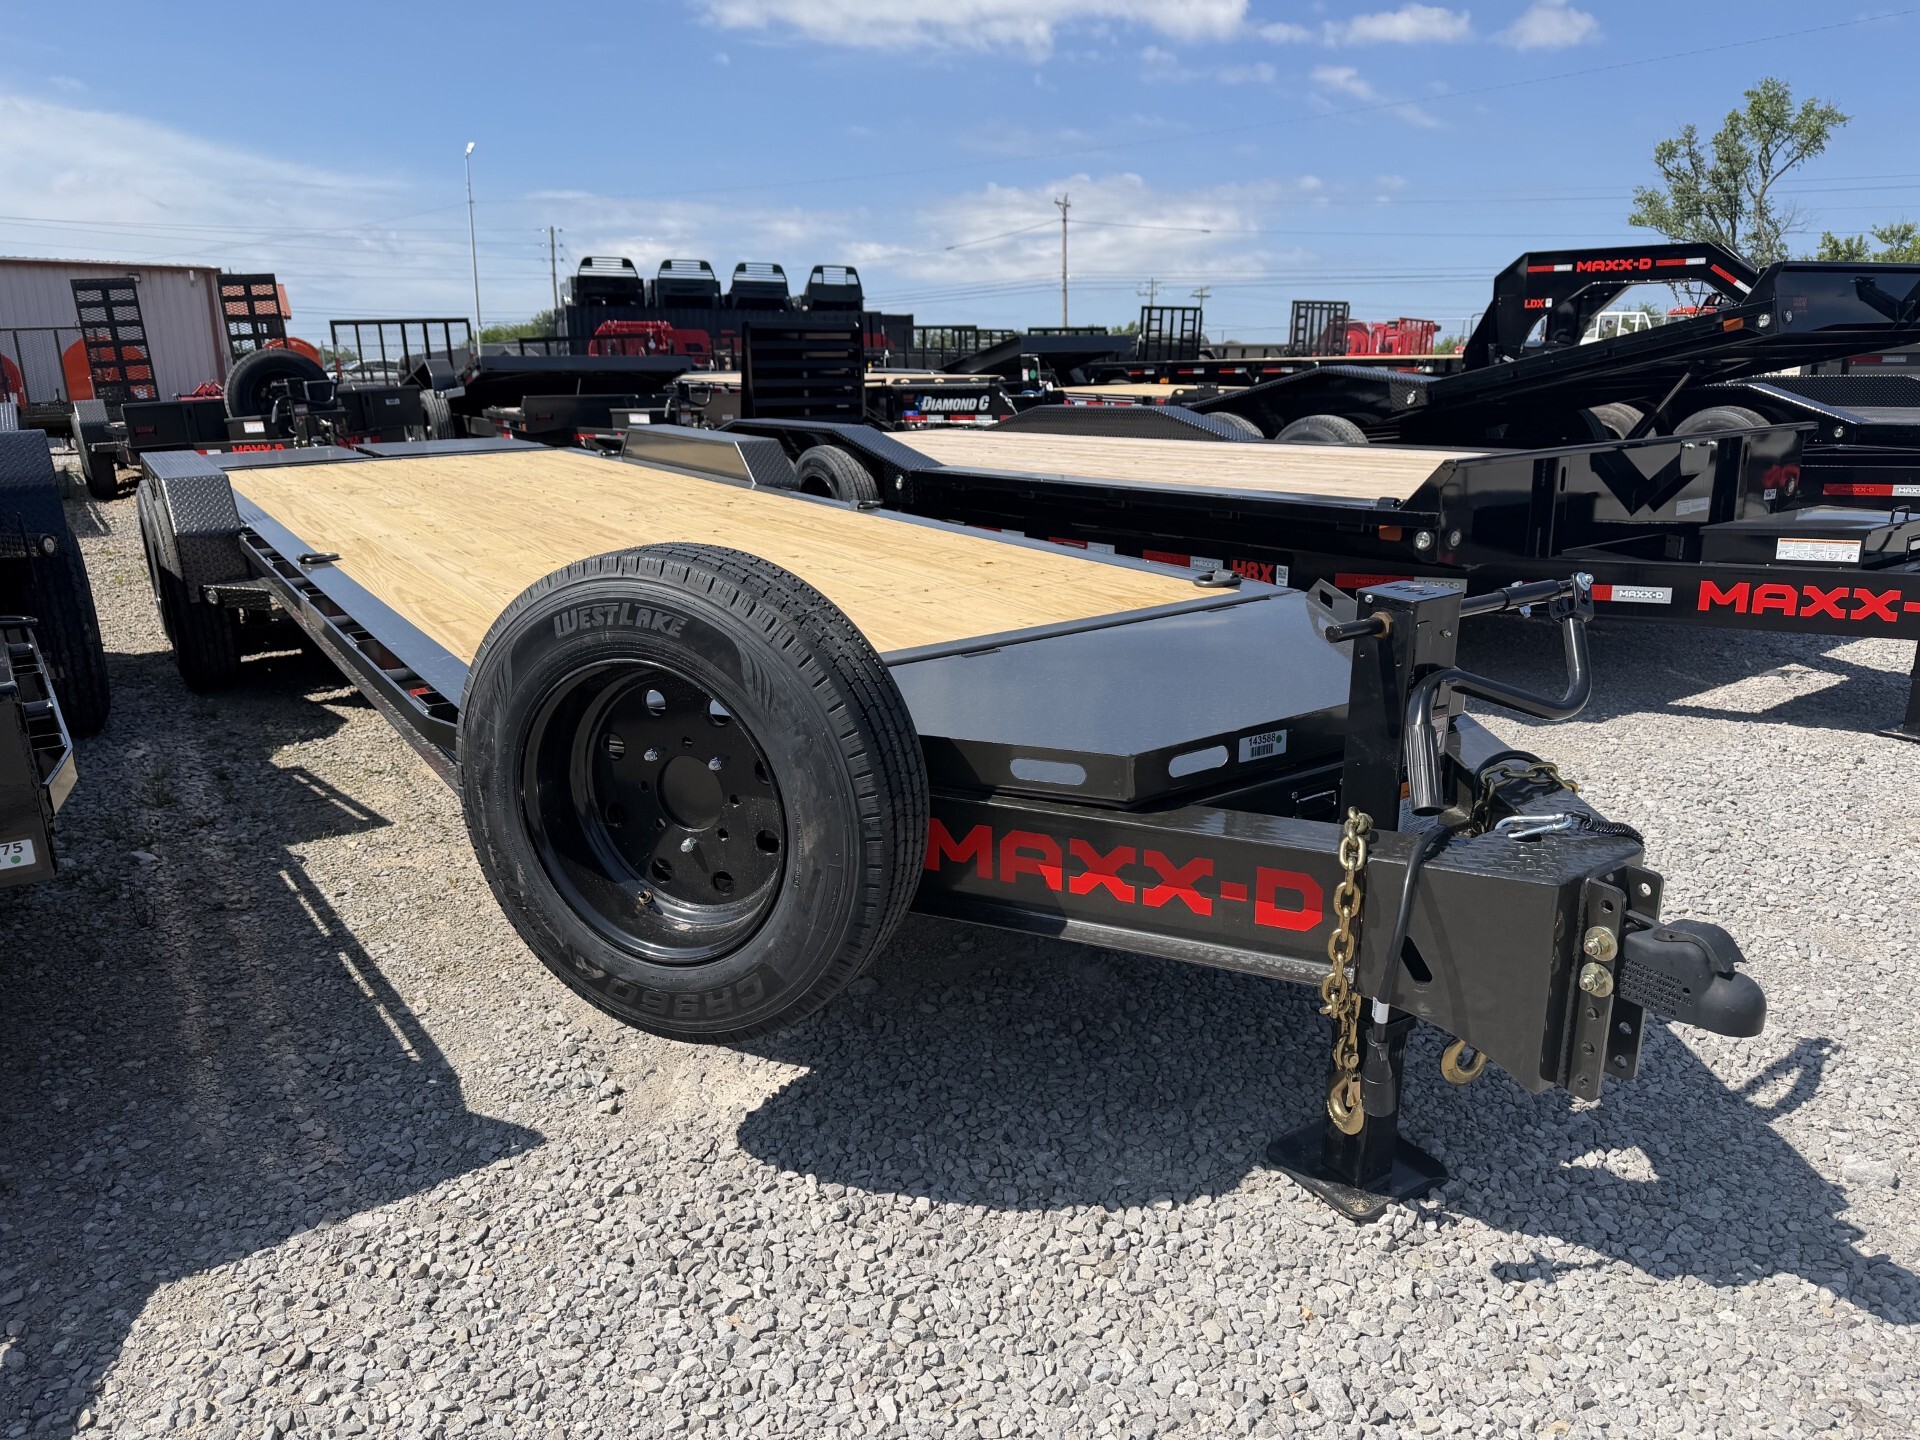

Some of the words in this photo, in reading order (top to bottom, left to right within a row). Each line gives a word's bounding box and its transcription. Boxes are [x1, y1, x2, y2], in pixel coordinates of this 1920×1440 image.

[1577, 258, 1651, 273] MAXX-D
[1524, 299, 1544, 308] LDX
[979, 395, 990, 411] C
[1619, 591, 1664, 599] MAXX-D
[1697, 580, 1920, 622] MAXX-
[1249, 733, 1276, 746] 143588
[924, 818, 1323, 932] MAXX-D
